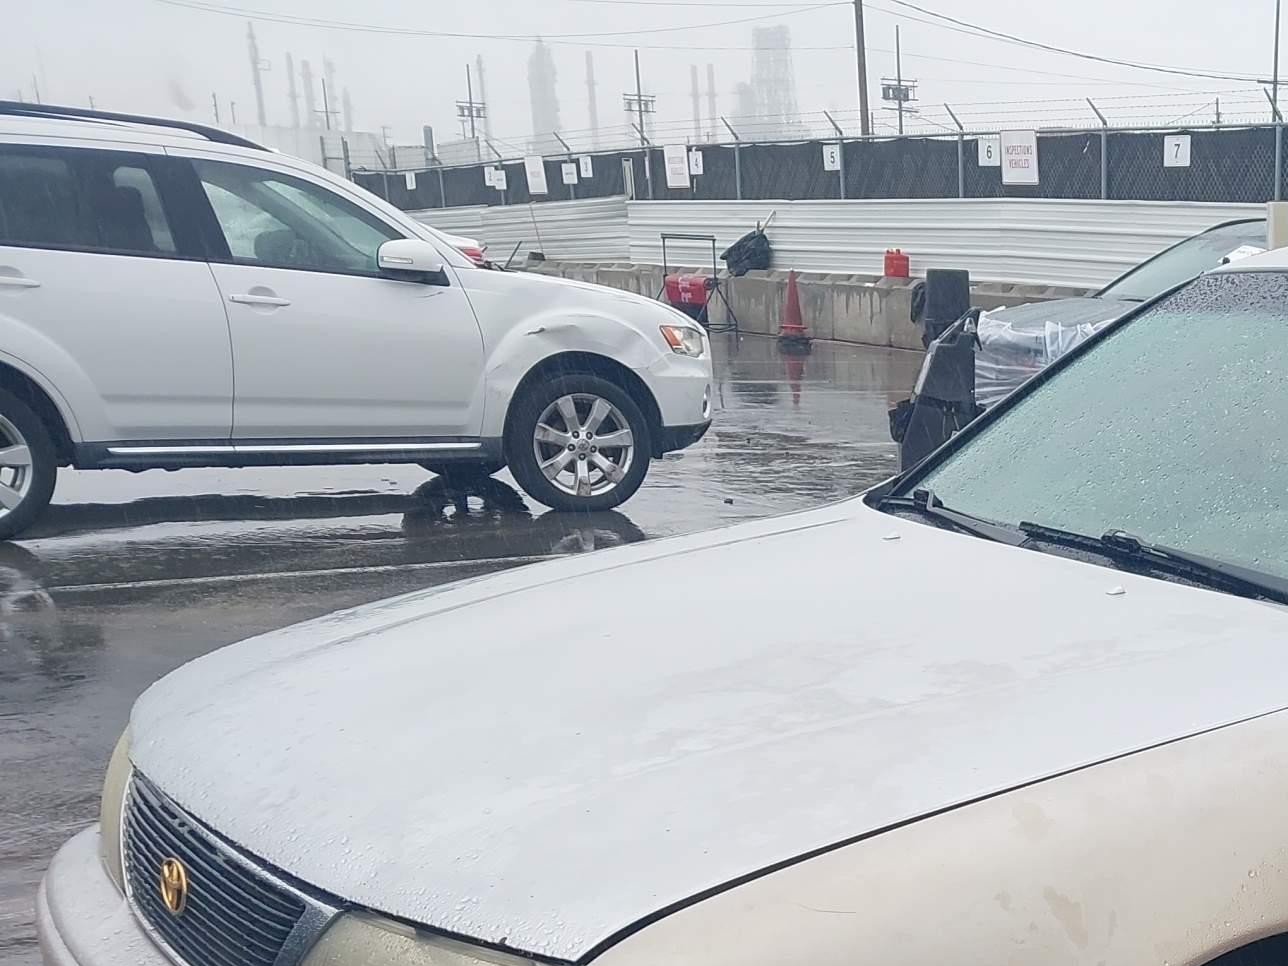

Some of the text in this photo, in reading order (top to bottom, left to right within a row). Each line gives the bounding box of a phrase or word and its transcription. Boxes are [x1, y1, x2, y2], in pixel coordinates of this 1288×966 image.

[986, 145, 993, 159] 6
[1004, 145, 1032, 155] INSPECTIONS
[1173, 144, 1181, 159] 7
[829, 151, 835, 164] 5
[1008, 158, 1029, 168] VEHICLES
